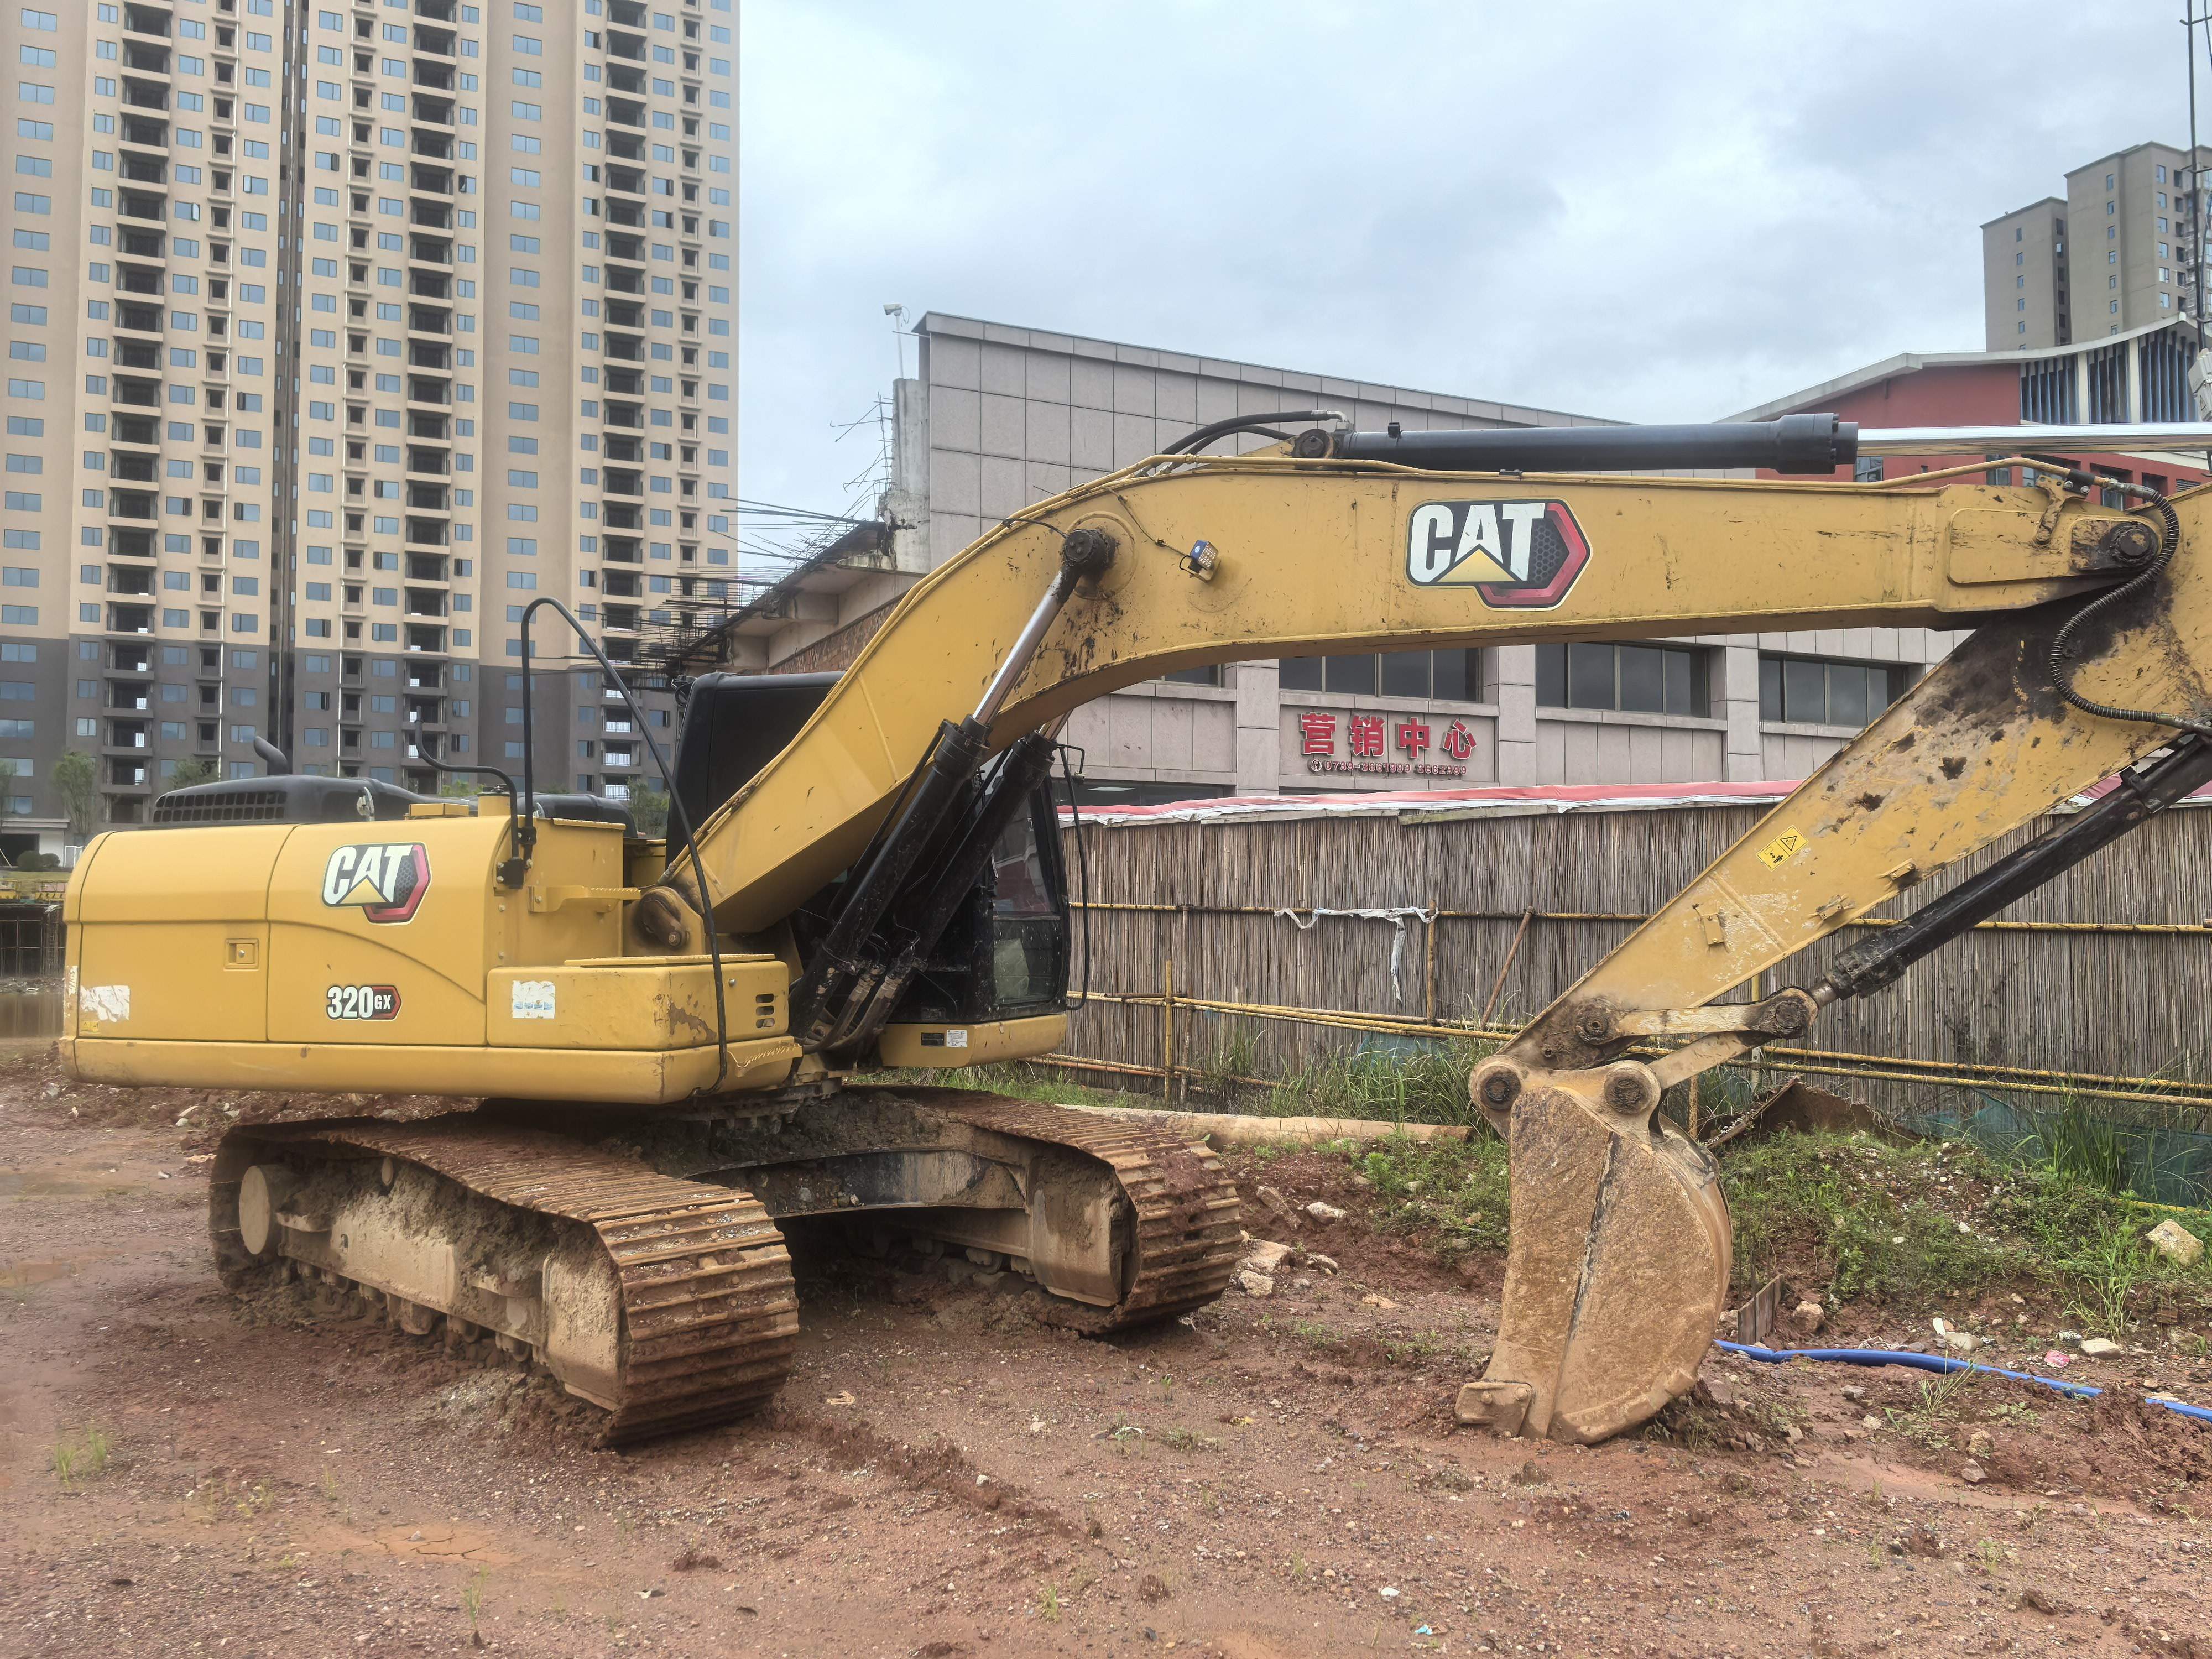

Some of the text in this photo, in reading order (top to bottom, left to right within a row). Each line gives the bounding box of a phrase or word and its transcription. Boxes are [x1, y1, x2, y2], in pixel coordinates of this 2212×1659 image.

[1410, 502, 1545, 583] CAT
[1300, 712, 1478, 760] 营销中心
[1324, 760, 1467, 775] 0739-3661999 3662999
[324, 844, 413, 905] CAT
